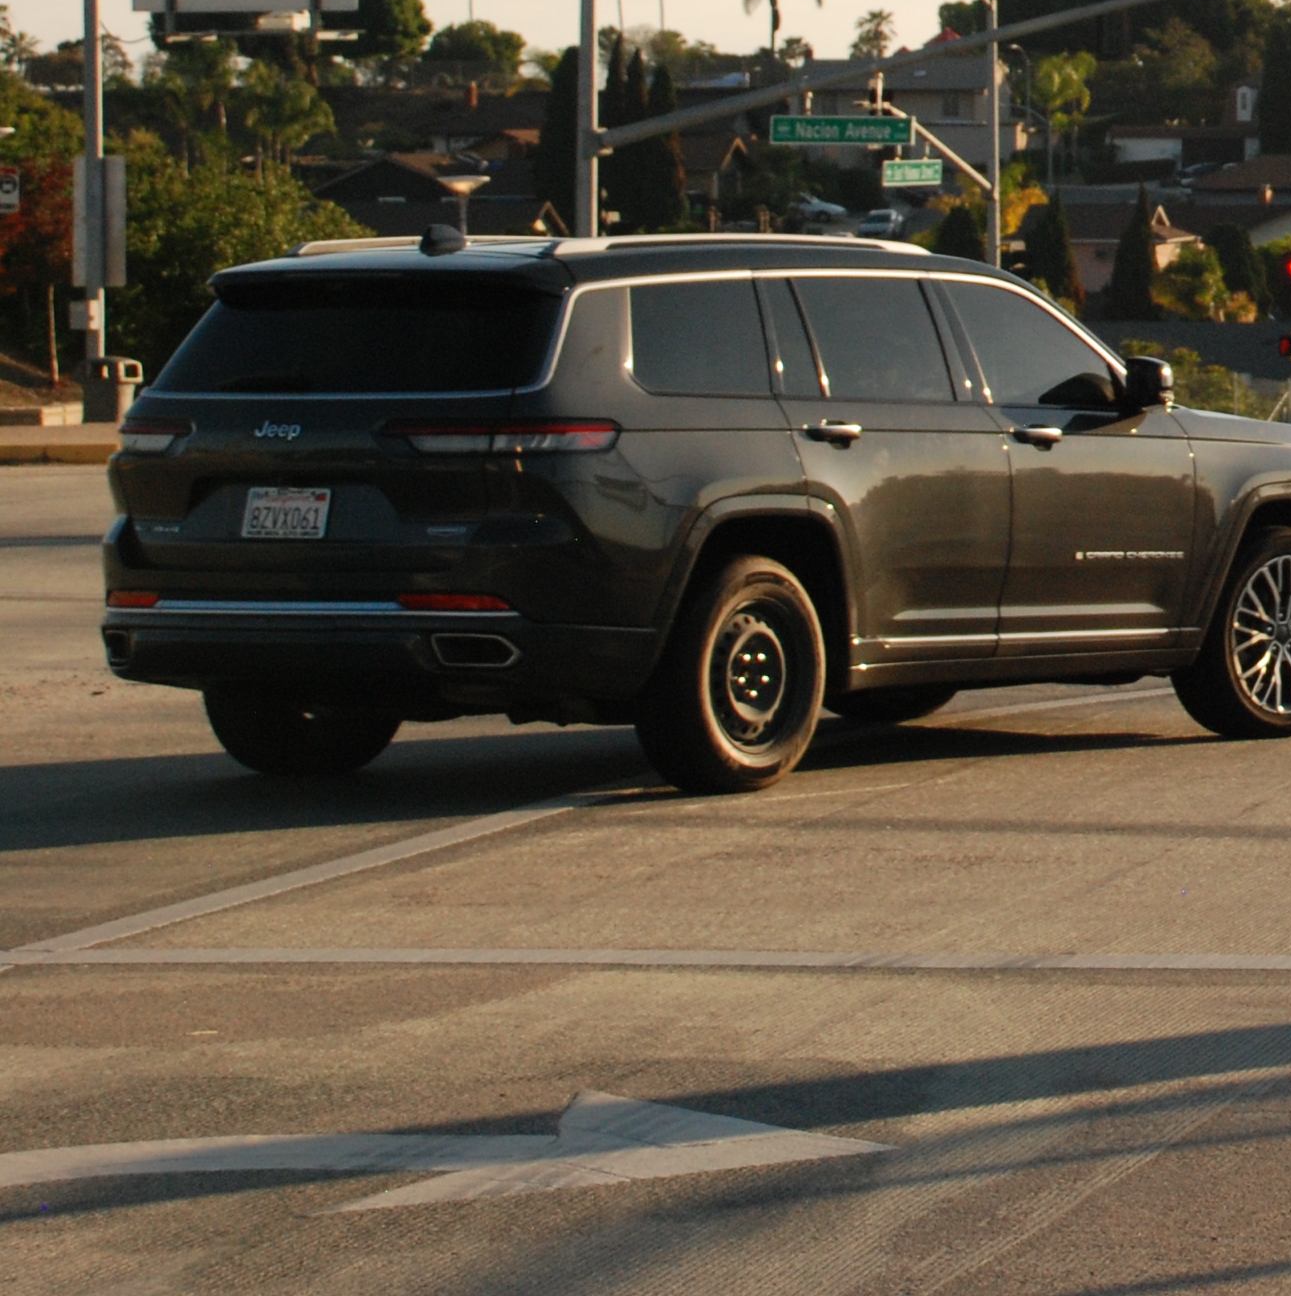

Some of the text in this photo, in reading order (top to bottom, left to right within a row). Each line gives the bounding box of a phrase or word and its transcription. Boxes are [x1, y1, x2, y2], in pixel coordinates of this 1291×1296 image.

[795, 121, 891, 139] Nacion Avenue
[254, 421, 301, 441] Jeep
[250, 506, 320, 531] 8ZVX061
